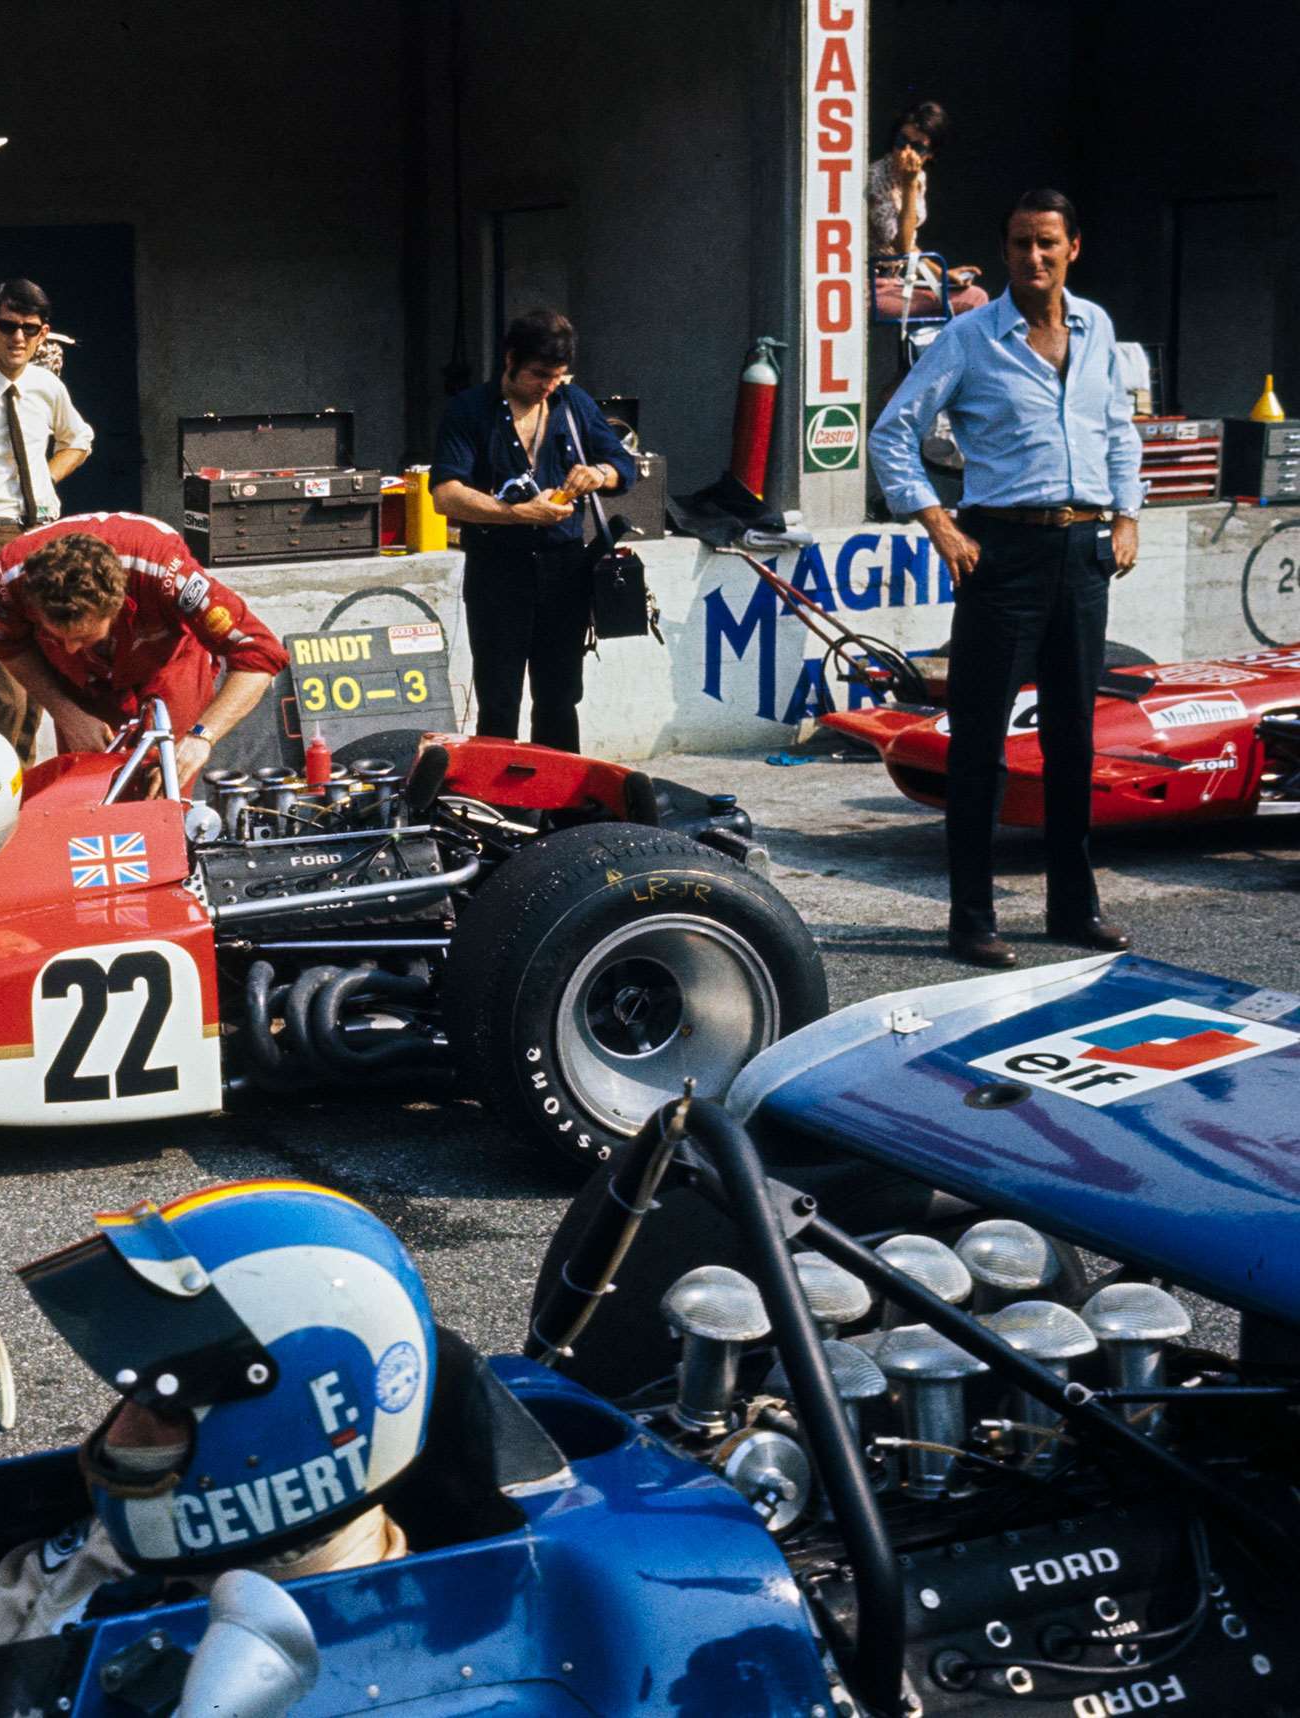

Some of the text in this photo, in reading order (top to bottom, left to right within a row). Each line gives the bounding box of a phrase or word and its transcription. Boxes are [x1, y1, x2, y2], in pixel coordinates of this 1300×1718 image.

[814, 0, 857, 394] CASTROL
[814, 430, 855, 445] Castrol
[185, 513, 208, 529] Shell
[1277, 557, 1300, 593] 2
[293, 635, 373, 665] RINDT
[1160, 702, 1238, 726] Marlboro
[1196, 758, 1235, 771] KONI
[290, 853, 343, 868] FORD
[41, 949, 180, 1105] 22
[1003, 1052, 1139, 1093] elf
[309, 1370, 360, 1435] F.
[171, 1434, 369, 1550] CEVERT
[1008, 1546, 1122, 1592] FORD
[1072, 1674, 1187, 1718] FORD
